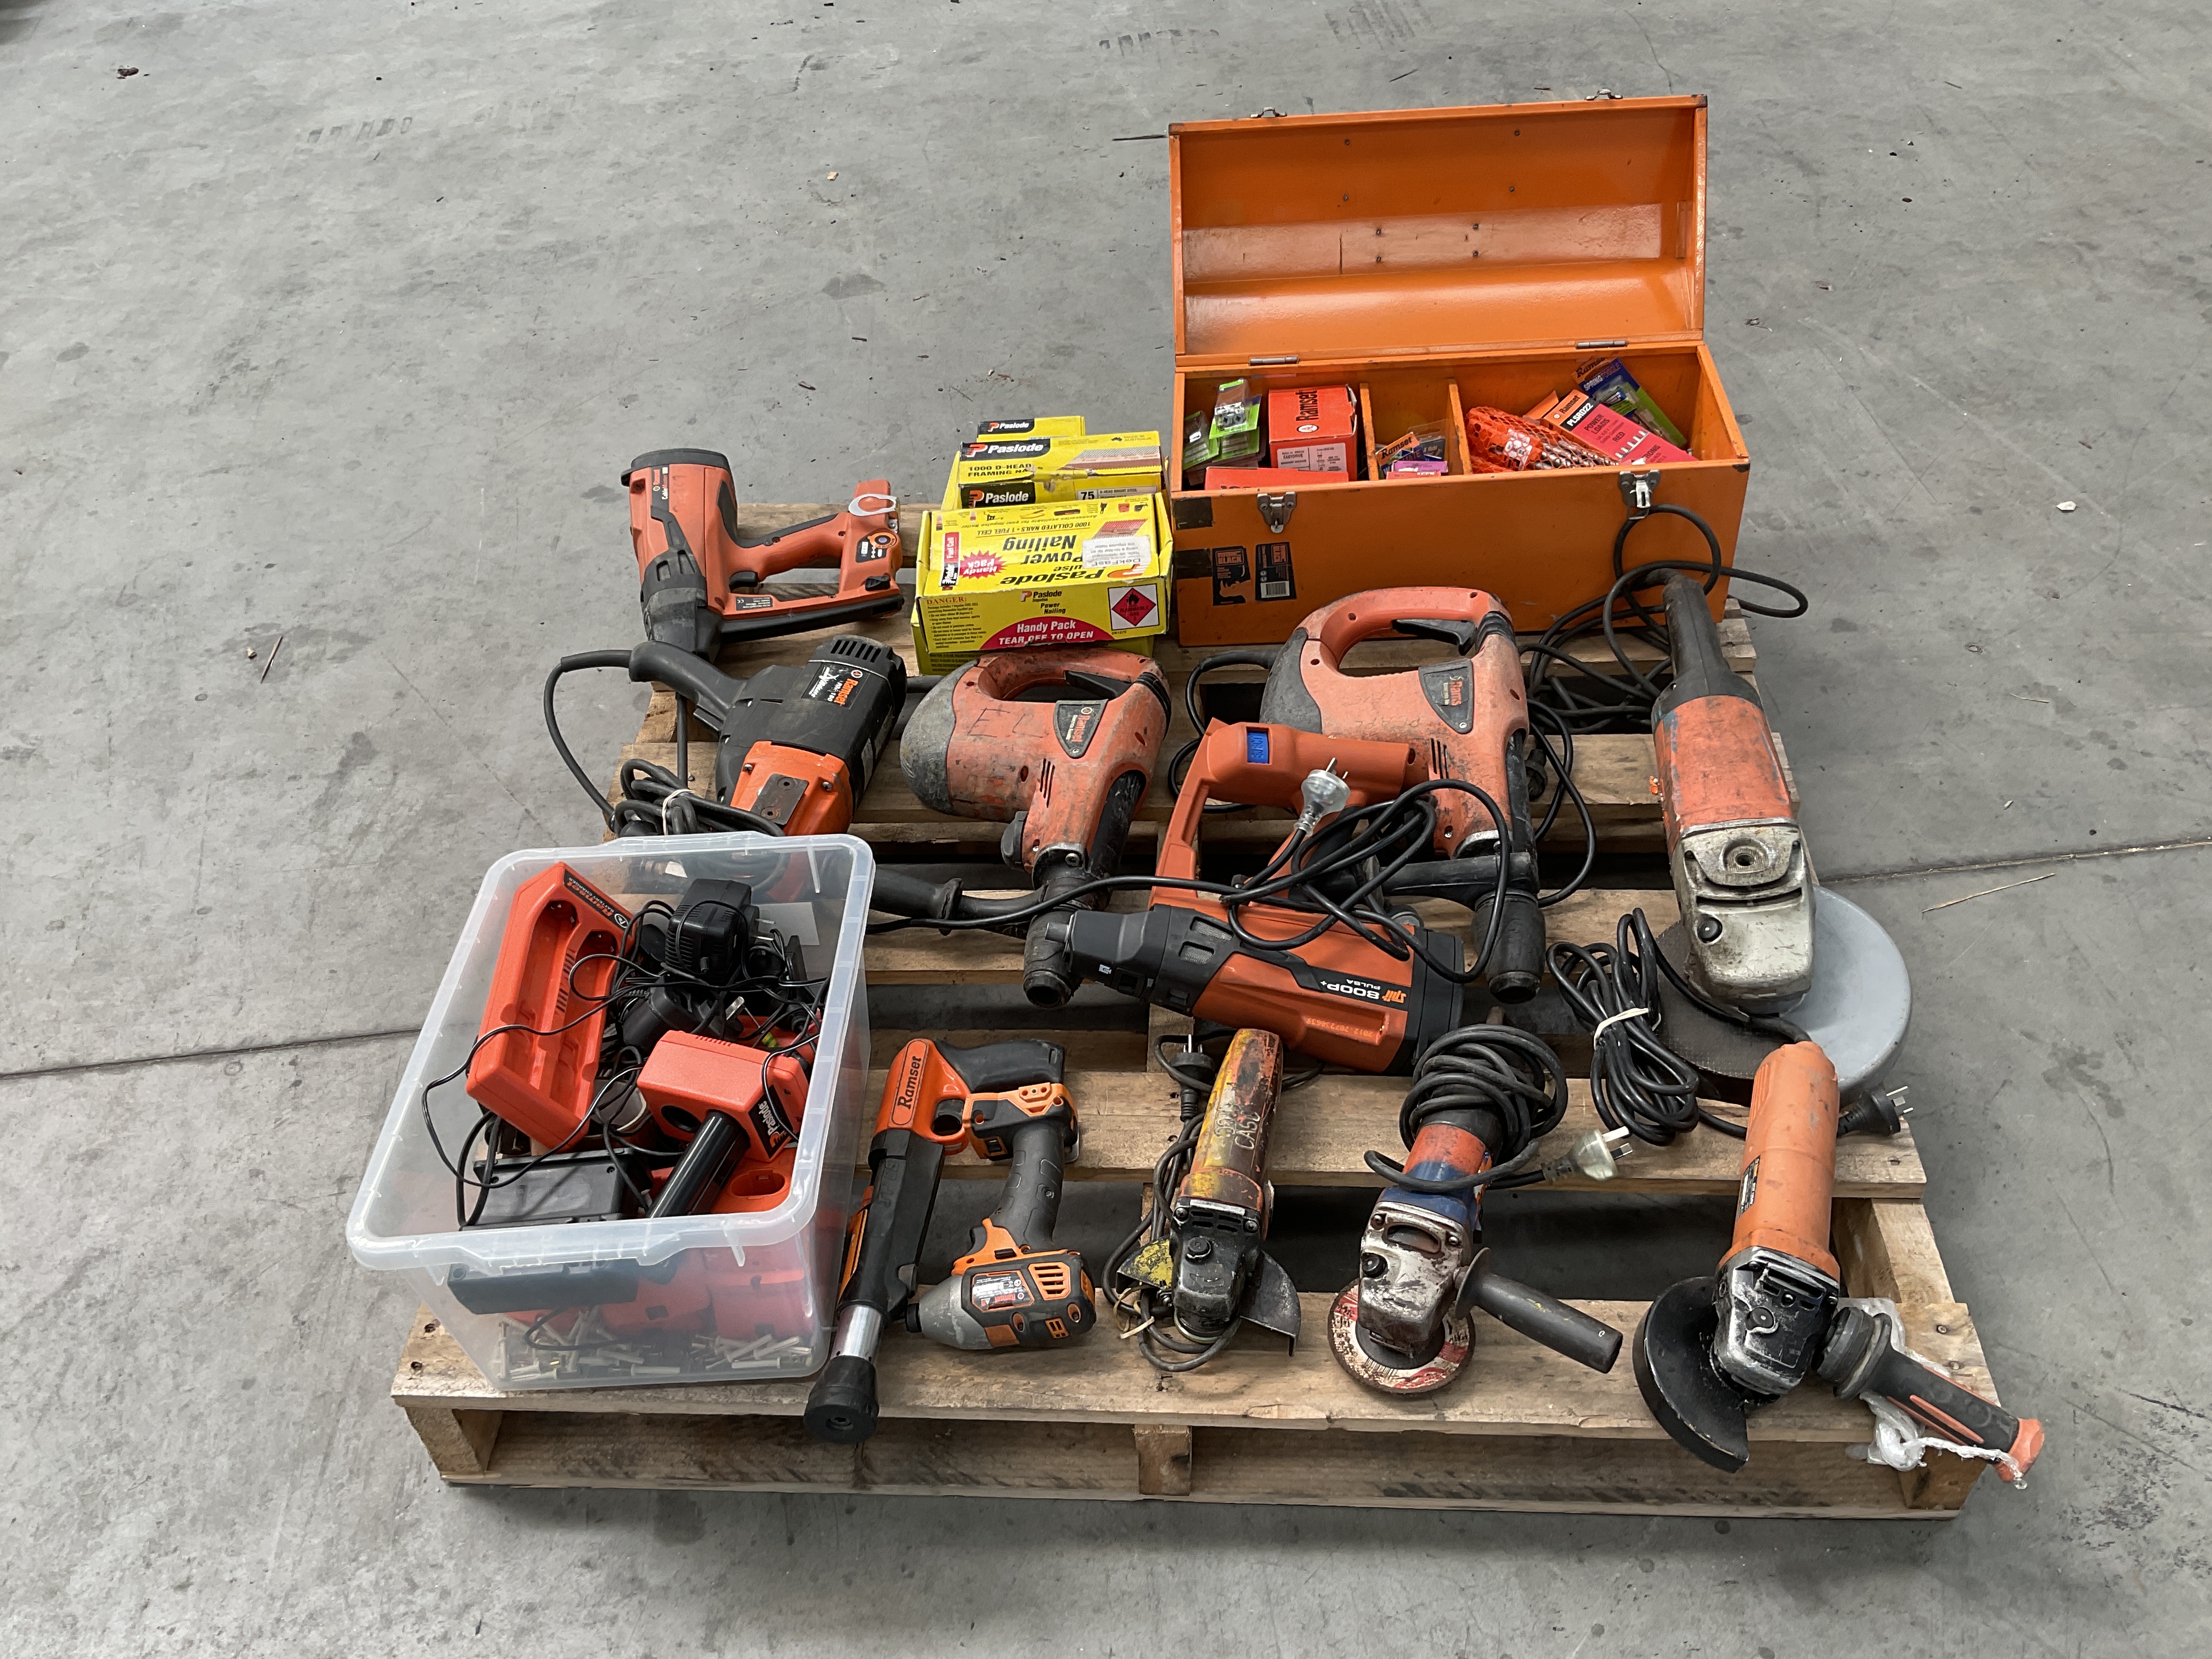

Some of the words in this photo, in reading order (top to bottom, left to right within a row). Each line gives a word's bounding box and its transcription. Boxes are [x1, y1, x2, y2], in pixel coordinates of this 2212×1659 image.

[1295, 390, 1319, 421] Ramset
[1559, 394, 1581, 414] Ramset
[1566, 403, 1593, 427] PLSRD22
[1584, 414, 1604, 431] POWER
[1591, 417, 1610, 435] LOADS
[1612, 431, 1626, 442] RED
[988, 443, 1043, 454] Paslode
[1381, 437, 1412, 460] Ramset
[985, 491, 1029, 504] Paslode
[1080, 491, 1095, 500] 75
[1002, 535, 1077, 552] Nailing
[963, 566, 998, 575] Handy
[967, 558, 995, 568] Pack
[1000, 569, 1105, 585] Paslode
[1033, 590, 1062, 599] Paslode
[1017, 622, 1048, 633] Handy
[1050, 619, 1076, 630] Pack
[1028, 634, 1048, 642] OFF
[1066, 631, 1093, 640] OPEN
[833, 678, 859, 705] Ramset
[1071, 715, 1091, 742] Ramset
[568, 877, 592, 896] CHARGER
[567, 881, 613, 917] Ramset
[592, 895, 614, 913] BATTERY
[1320, 980, 1380, 1000] 800P+
[1346, 979, 1381, 990] PULSA
[897, 1055, 922, 1109] Ramset
[759, 1100, 780, 1136] Paslode
[995, 1293, 1016, 1304] Ramset
